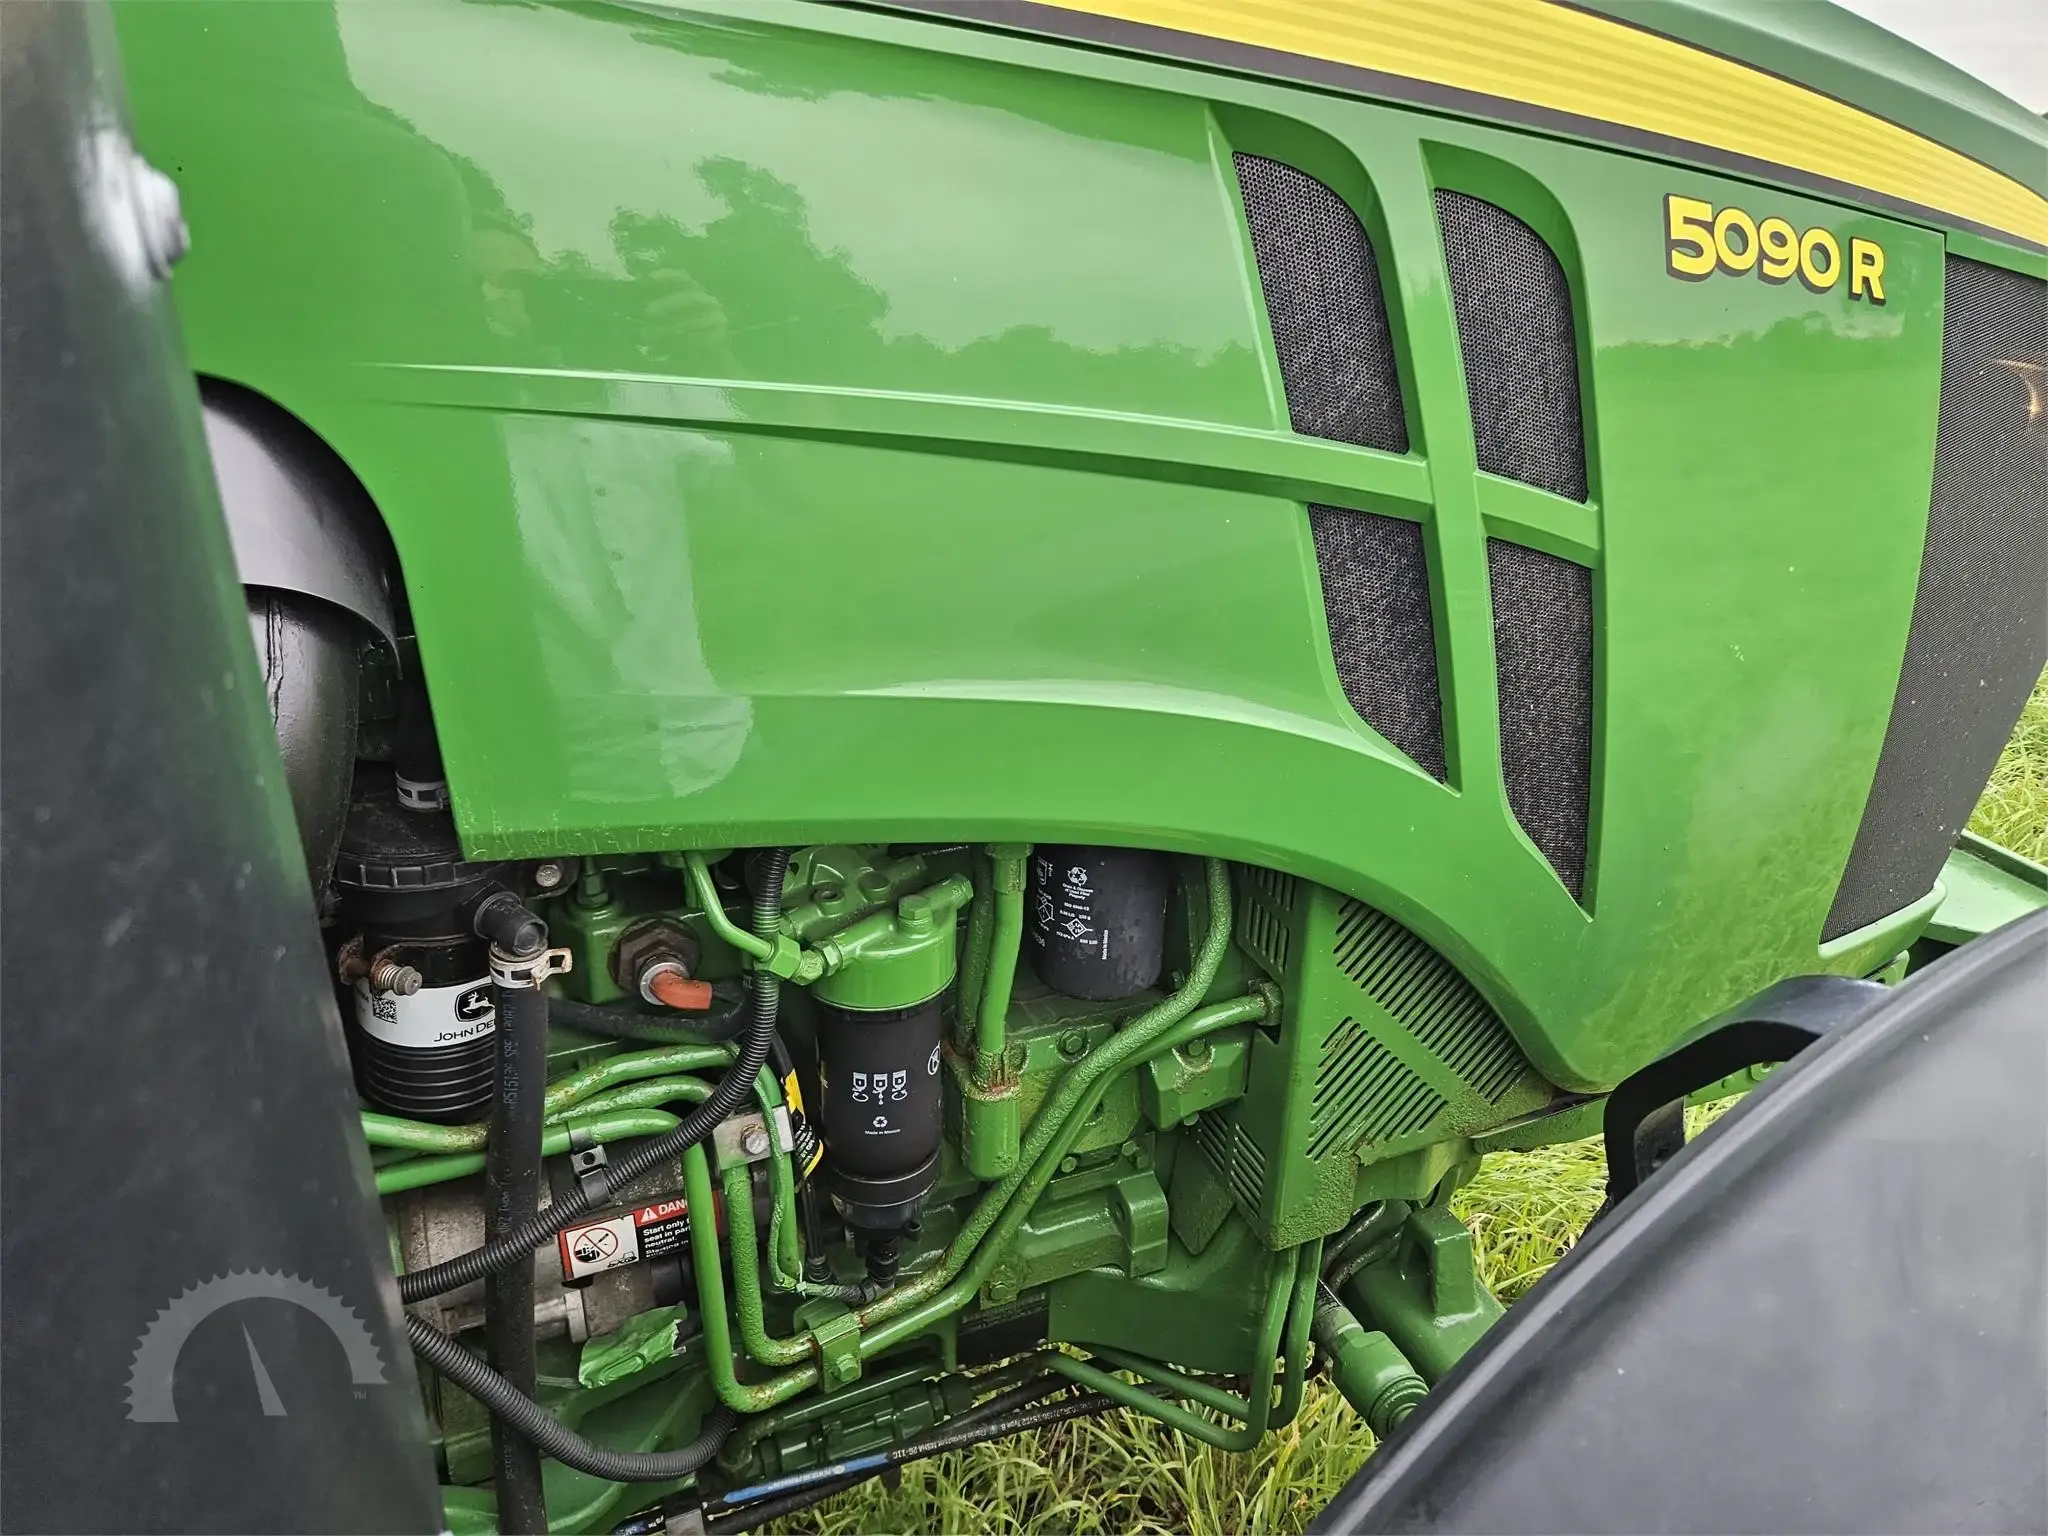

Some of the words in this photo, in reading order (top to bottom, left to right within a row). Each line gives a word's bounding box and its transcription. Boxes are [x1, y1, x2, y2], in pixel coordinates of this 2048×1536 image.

[1663, 193, 1841, 294] 5090
[1849, 236, 1887, 306] R
[434, 1027, 474, 1042] JOHN
[475, 1020, 496, 1034] DE
[658, 1199, 688, 1215] DAN
[643, 1225, 664, 1236] Start
[666, 1220, 685, 1231] only
[644, 1233, 663, 1243] seat
[645, 1236, 678, 1249] neutral.
[893, 1446, 918, 1459] 2G-11C
